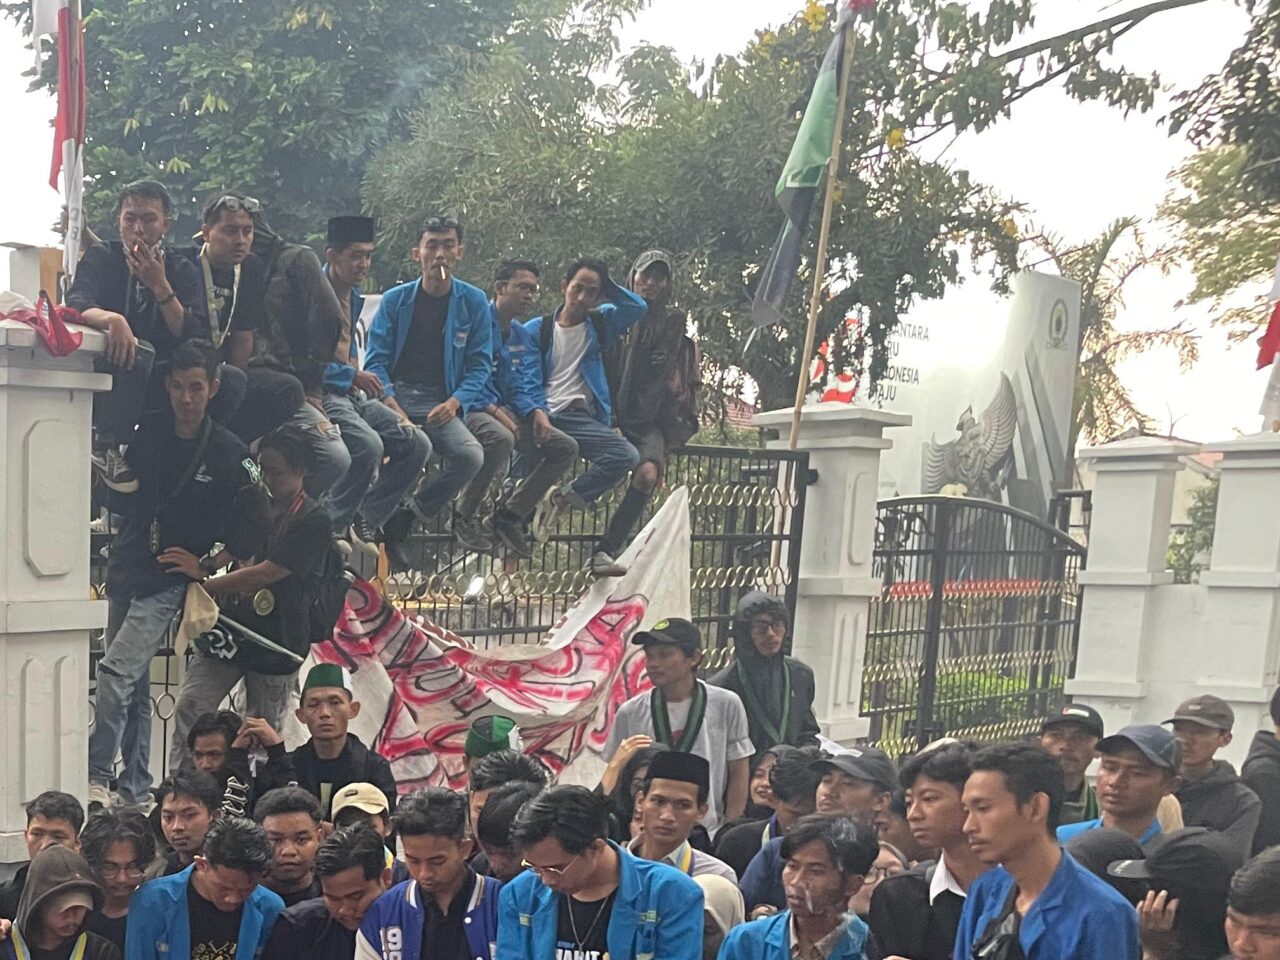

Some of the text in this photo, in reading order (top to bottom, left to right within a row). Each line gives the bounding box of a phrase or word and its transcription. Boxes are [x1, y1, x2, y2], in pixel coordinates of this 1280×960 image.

[887, 323, 929, 341] ANTARA
[887, 340, 899, 356] RU
[884, 365, 919, 384] ONESIA
